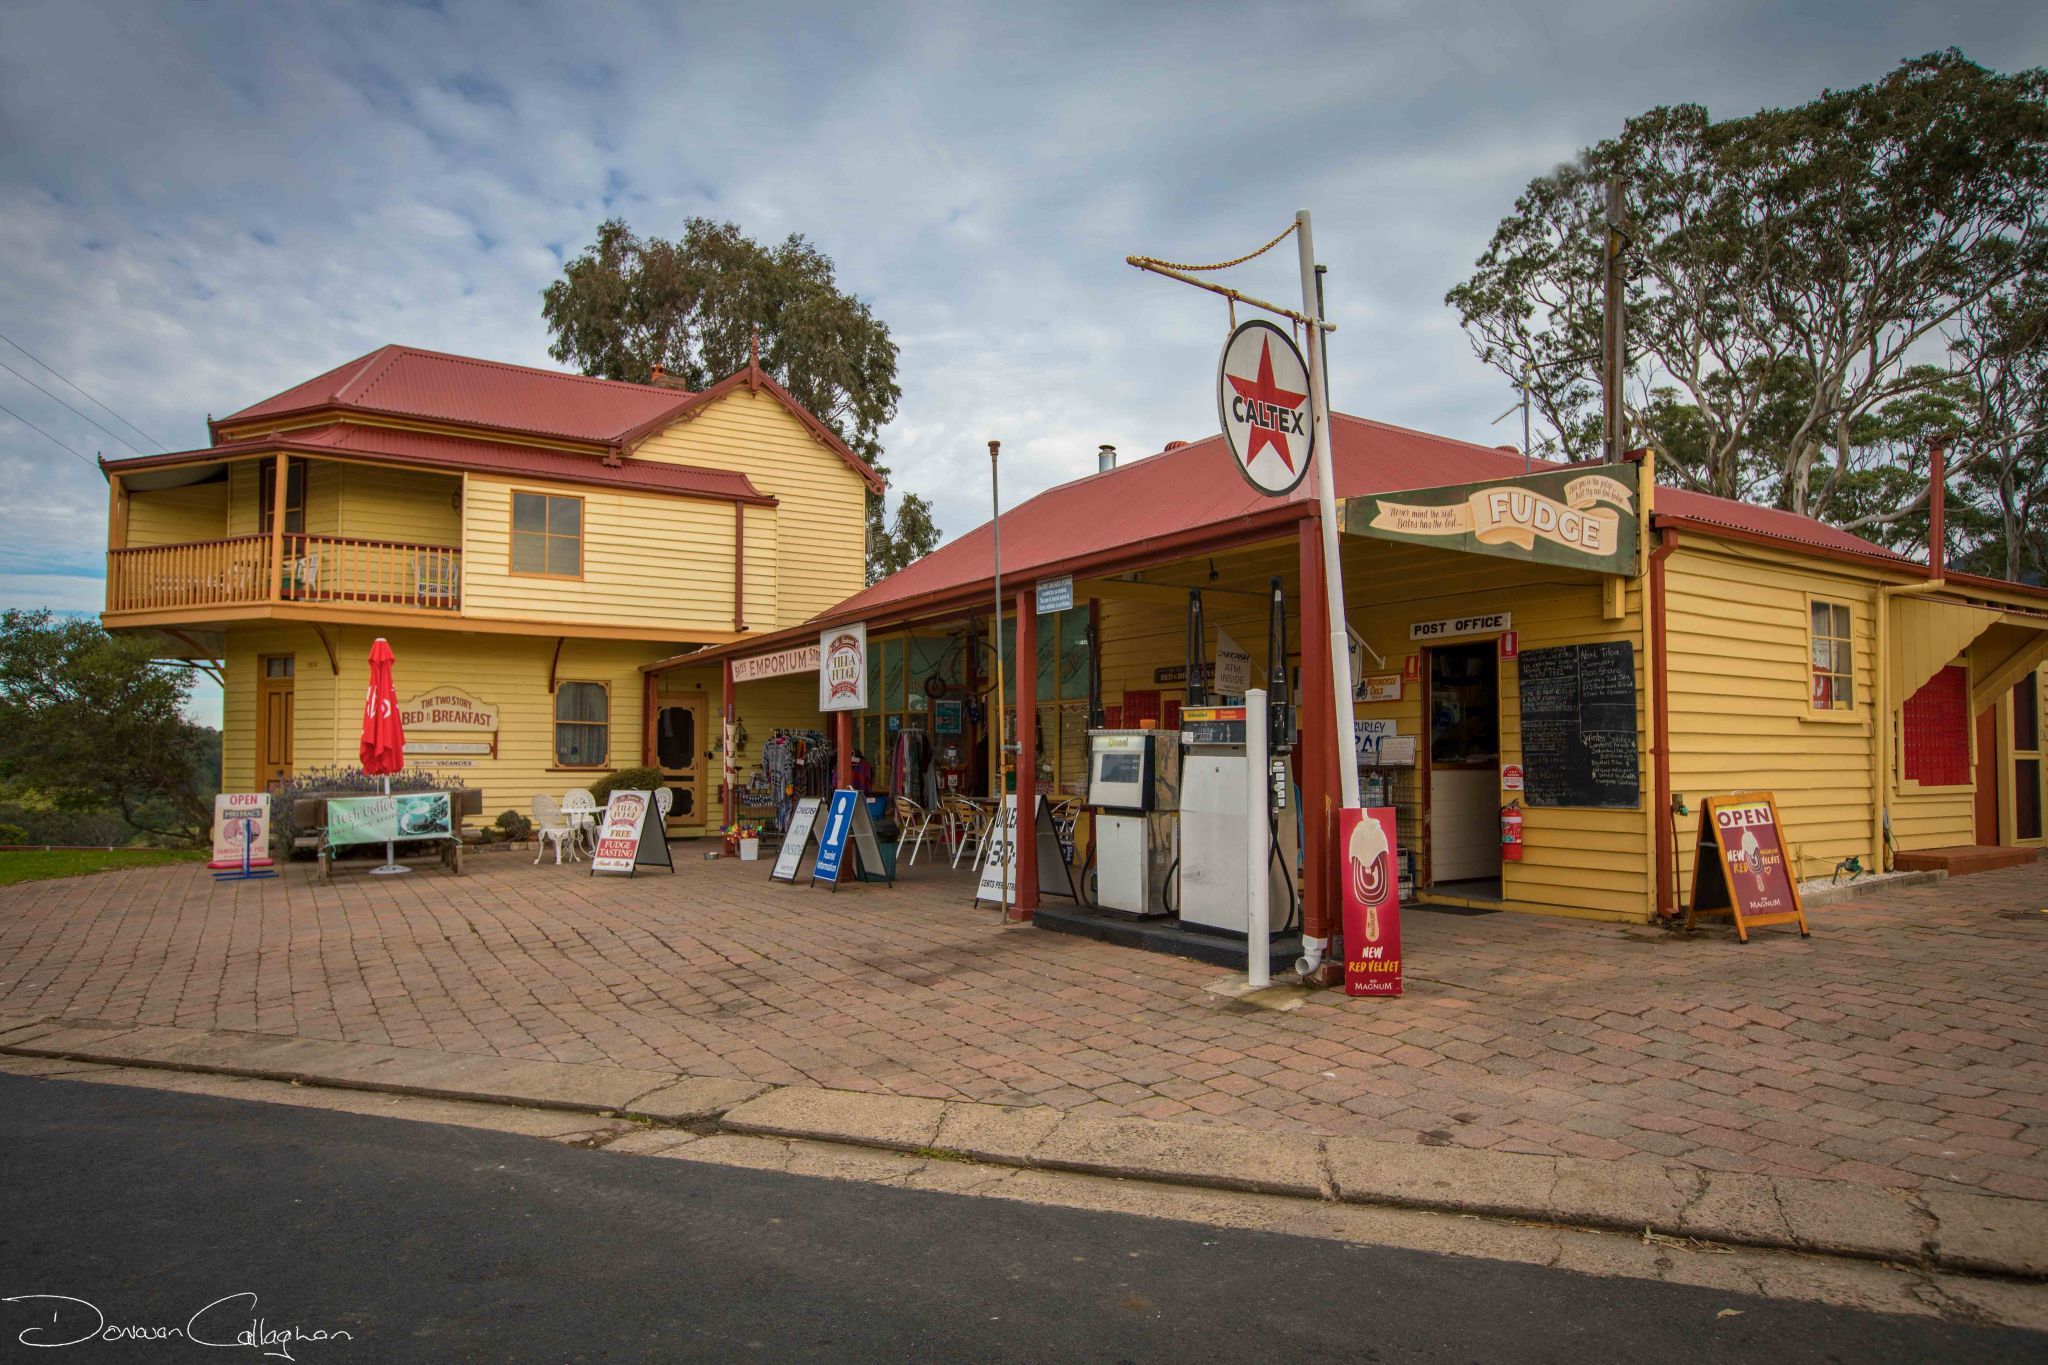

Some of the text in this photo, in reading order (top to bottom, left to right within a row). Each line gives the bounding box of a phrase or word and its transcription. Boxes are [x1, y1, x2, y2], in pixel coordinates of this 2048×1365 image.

[1232, 396, 1304, 436] CALTEX
[1390, 507, 1409, 517] Never
[1411, 509, 1428, 518] mind
[1430, 509, 1439, 518] the
[1396, 518, 1418, 529] Bates
[1419, 519, 1432, 528] has
[1433, 519, 1442, 528] the
[1489, 493, 1600, 549] FUDGE
[1414, 616, 1503, 636] POST OFFICE
[749, 651, 807, 677] EMPORIUM
[1224, 664, 1241, 673] ATM
[1220, 673, 1244, 685] INSIDE
[421, 696, 473, 710] THE TWO STORY
[402, 711, 424, 725] BED
[432, 710, 492, 727] BREAKFAST
[230, 794, 258, 805] OPEN
[363, 798, 397, 817] Coffee
[1717, 808, 1771, 827] OPEN
[610, 829, 632, 838] FREE
[604, 840, 632, 849] FUDGE
[599, 848, 633, 858] TASTING
[1726, 849, 1745, 863] NEW
[1733, 863, 1748, 874] RED
[1750, 899, 1781, 909] MAGNUM
[1362, 946, 1384, 959] NEW
[1349, 960, 1400, 973] RED VELVET
